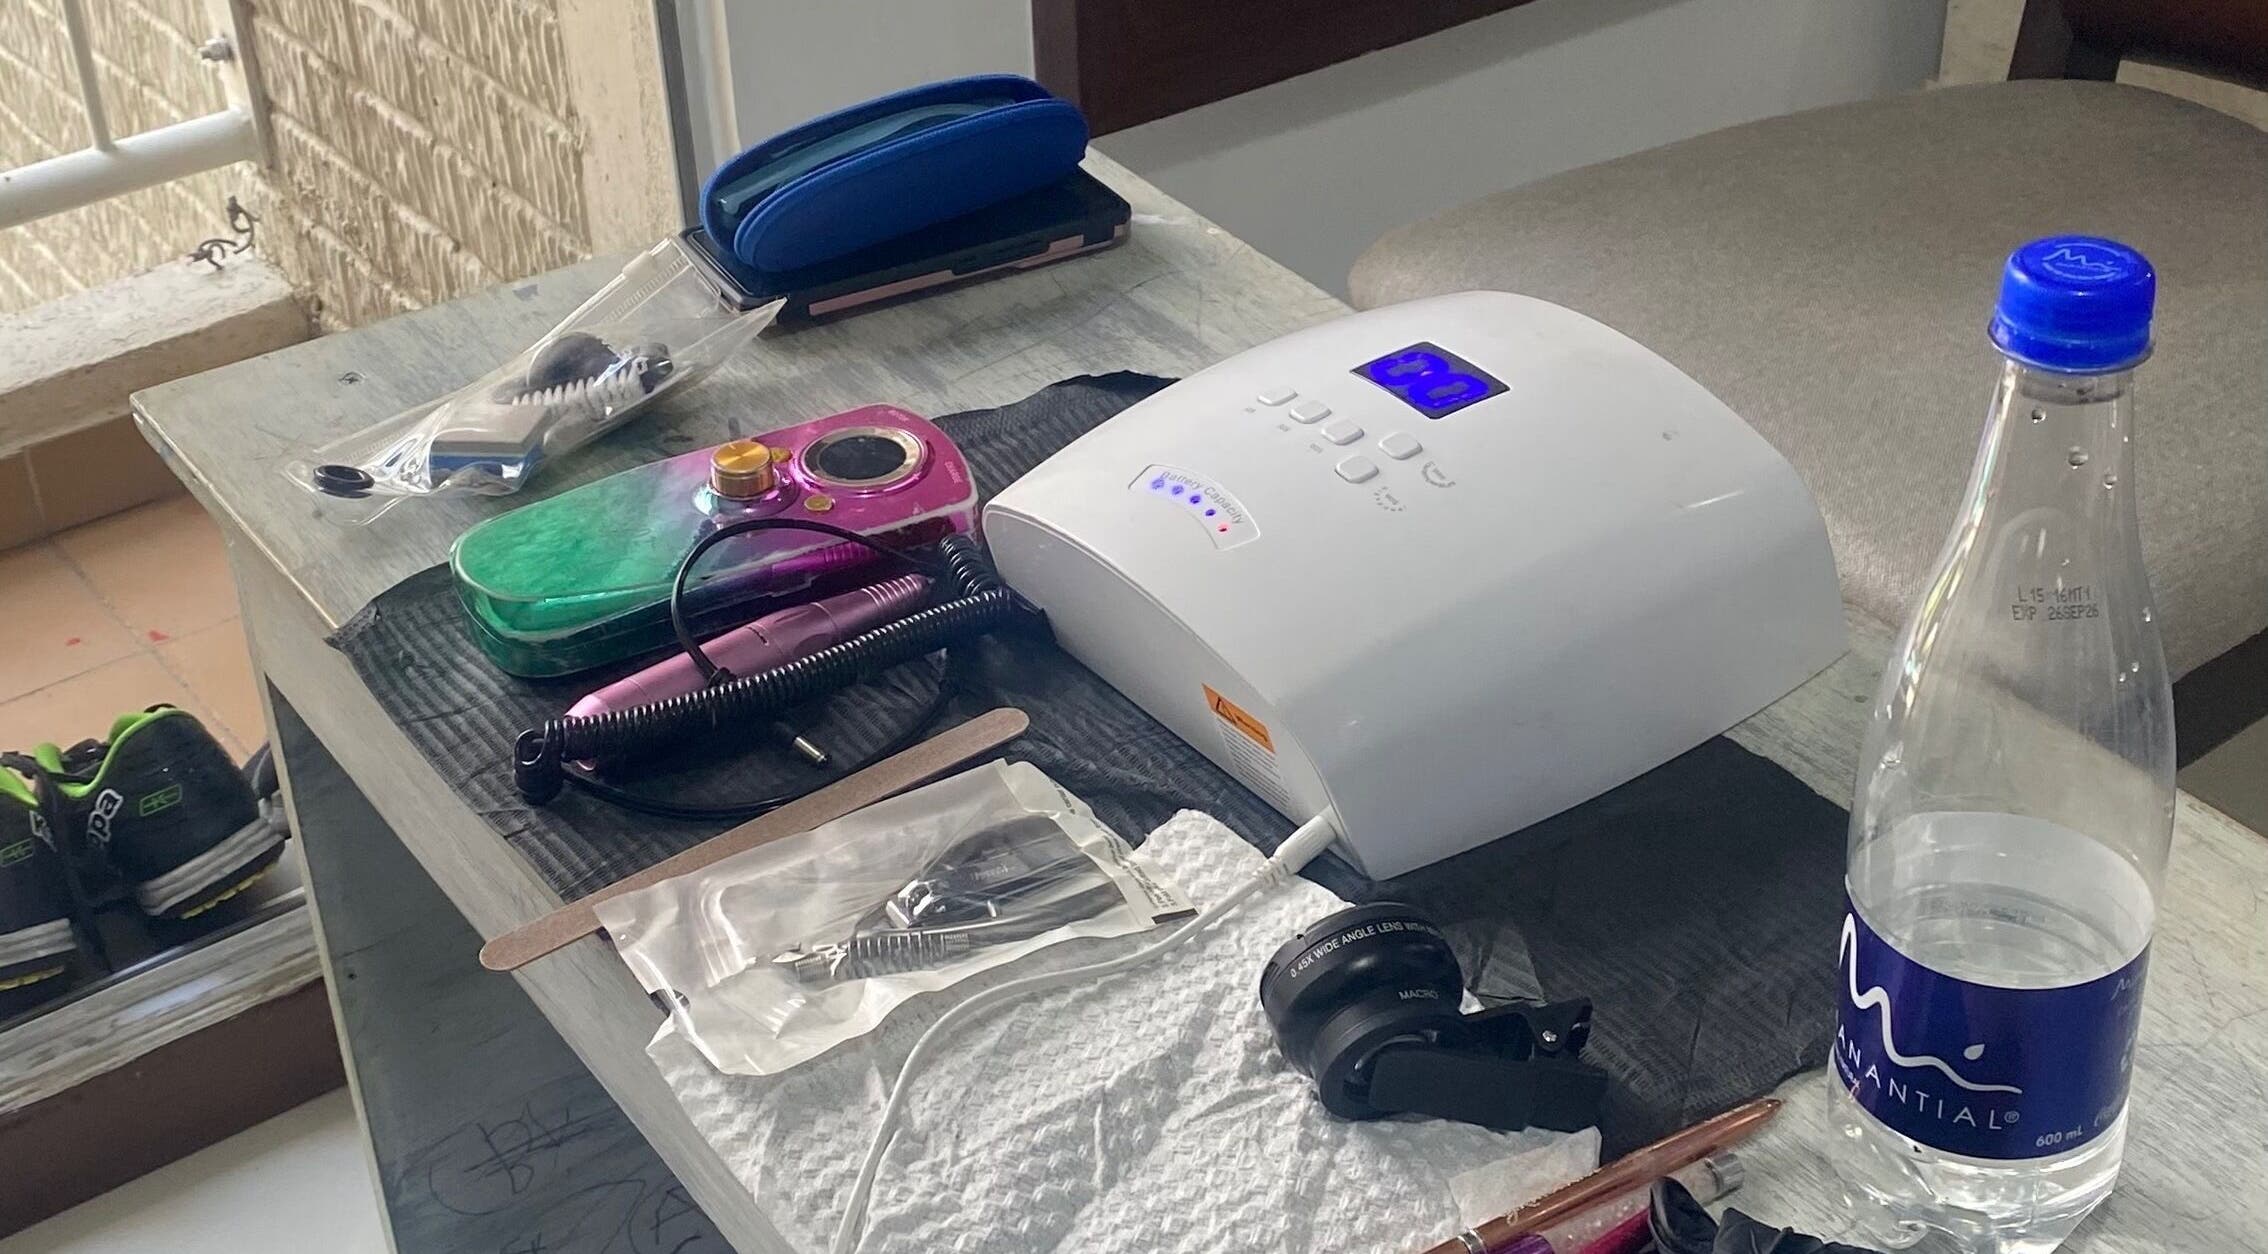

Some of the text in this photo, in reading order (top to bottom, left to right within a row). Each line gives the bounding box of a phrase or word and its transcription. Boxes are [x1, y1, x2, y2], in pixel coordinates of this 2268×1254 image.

[1370, 351, 1489, 408] 00
[1204, 486, 1245, 525] Capacity
[2011, 603, 2099, 621] EXP 26SEP26
[1313, 938, 1340, 960] WIDE
[1341, 924, 1376, 945] ANGLE
[1377, 921, 1404, 936] LENS
[1399, 989, 1439, 1001] MACRO
[2035, 1125, 2083, 1148] 600 mL
